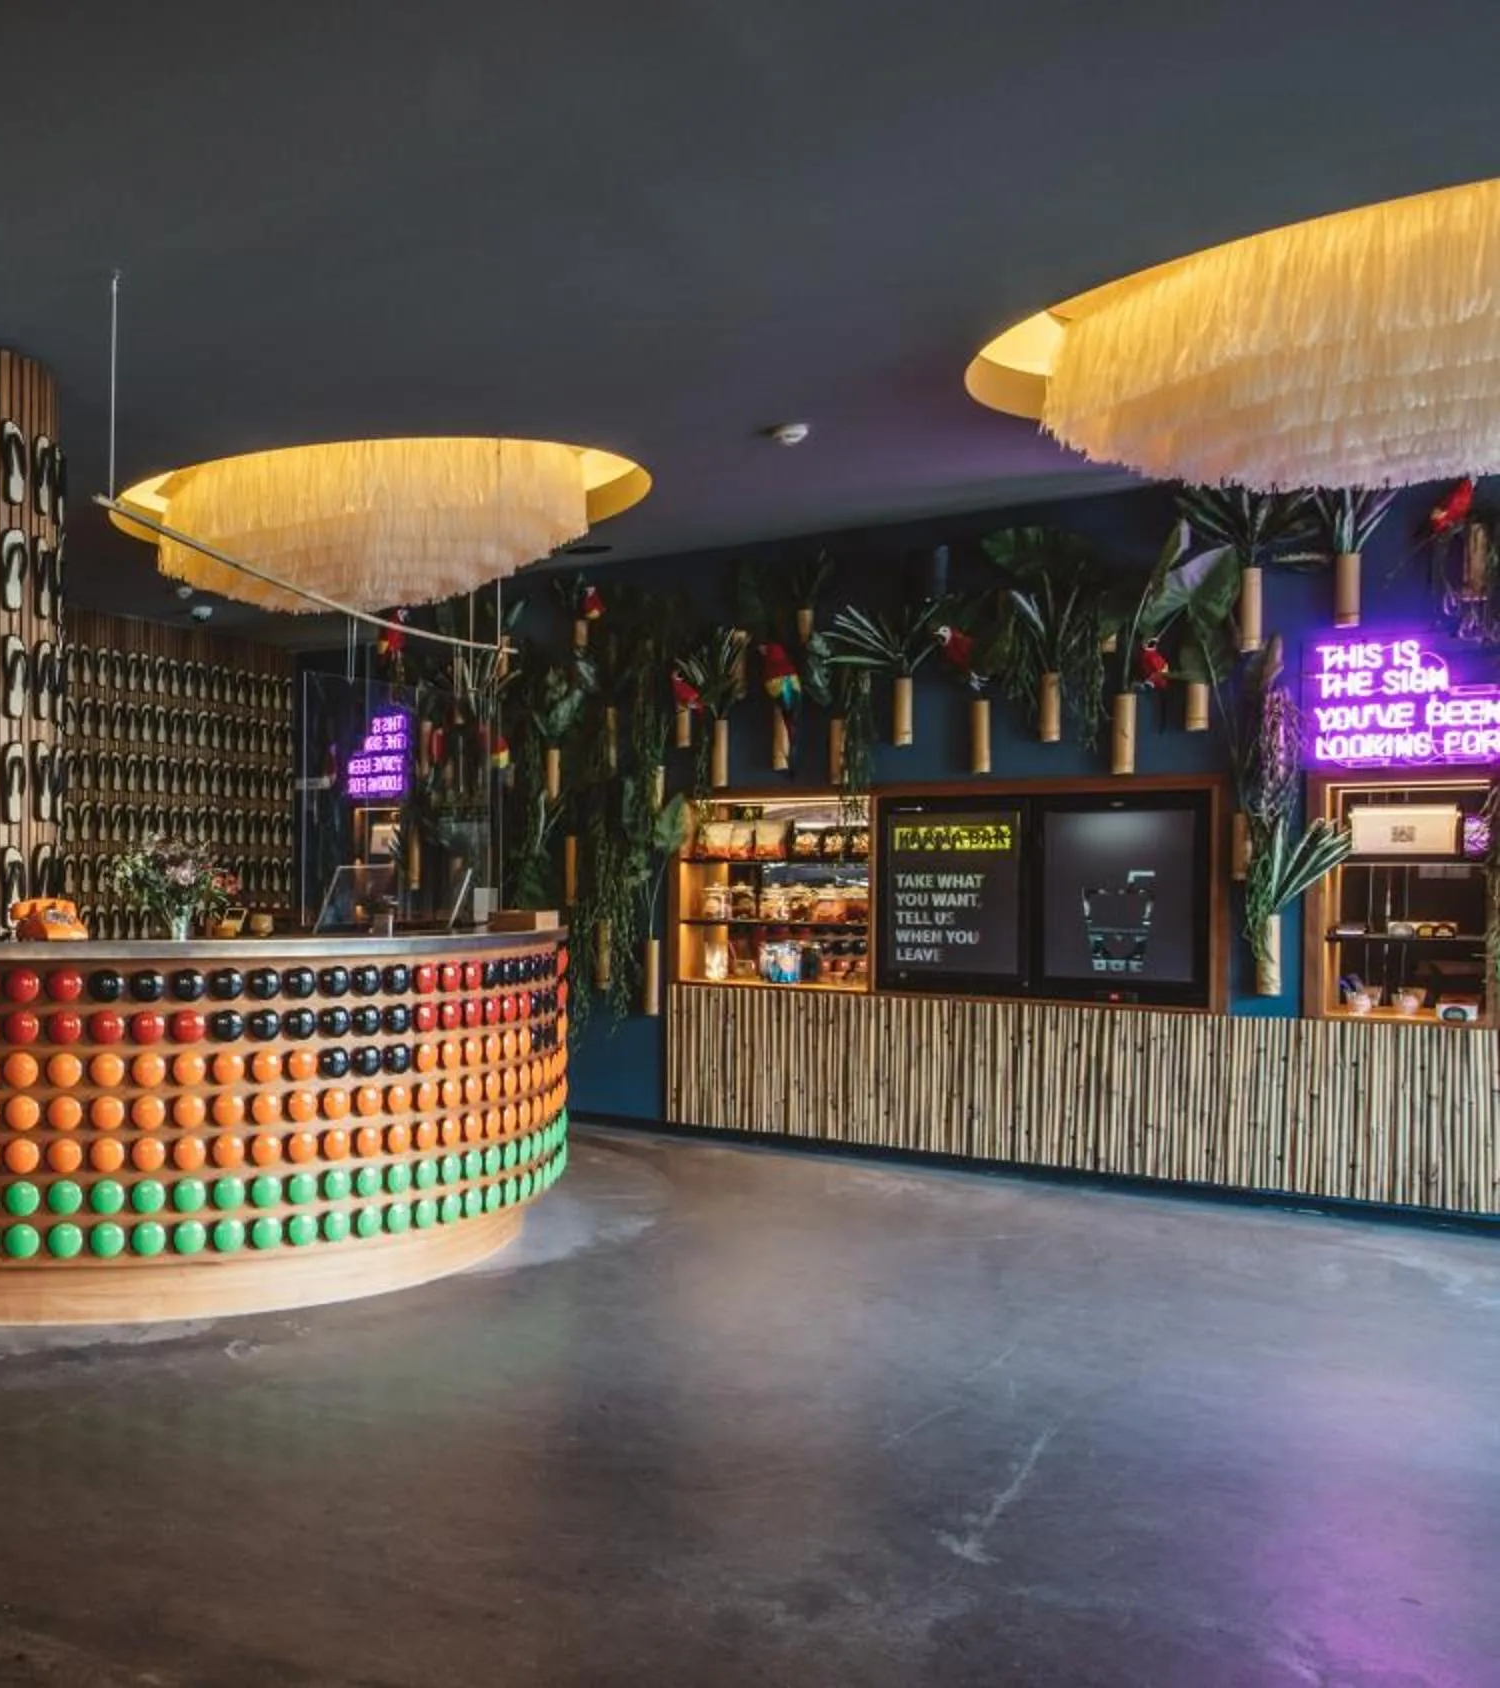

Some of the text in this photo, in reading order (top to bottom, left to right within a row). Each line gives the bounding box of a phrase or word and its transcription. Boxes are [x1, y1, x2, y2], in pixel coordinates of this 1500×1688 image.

[1315, 640, 1420, 671] THIS IS
[1315, 666, 1448, 699] THE SIGN
[1314, 702, 1415, 732] YOU'VE
[1315, 729, 1500, 760] LOOKING FOR
[896, 874, 985, 888] TAKE WHAT
[895, 893, 929, 907] YOU
[895, 911, 955, 925] TELL US
[895, 929, 980, 944] WHEN YOU
[895, 948, 944, 962] LEAVE
